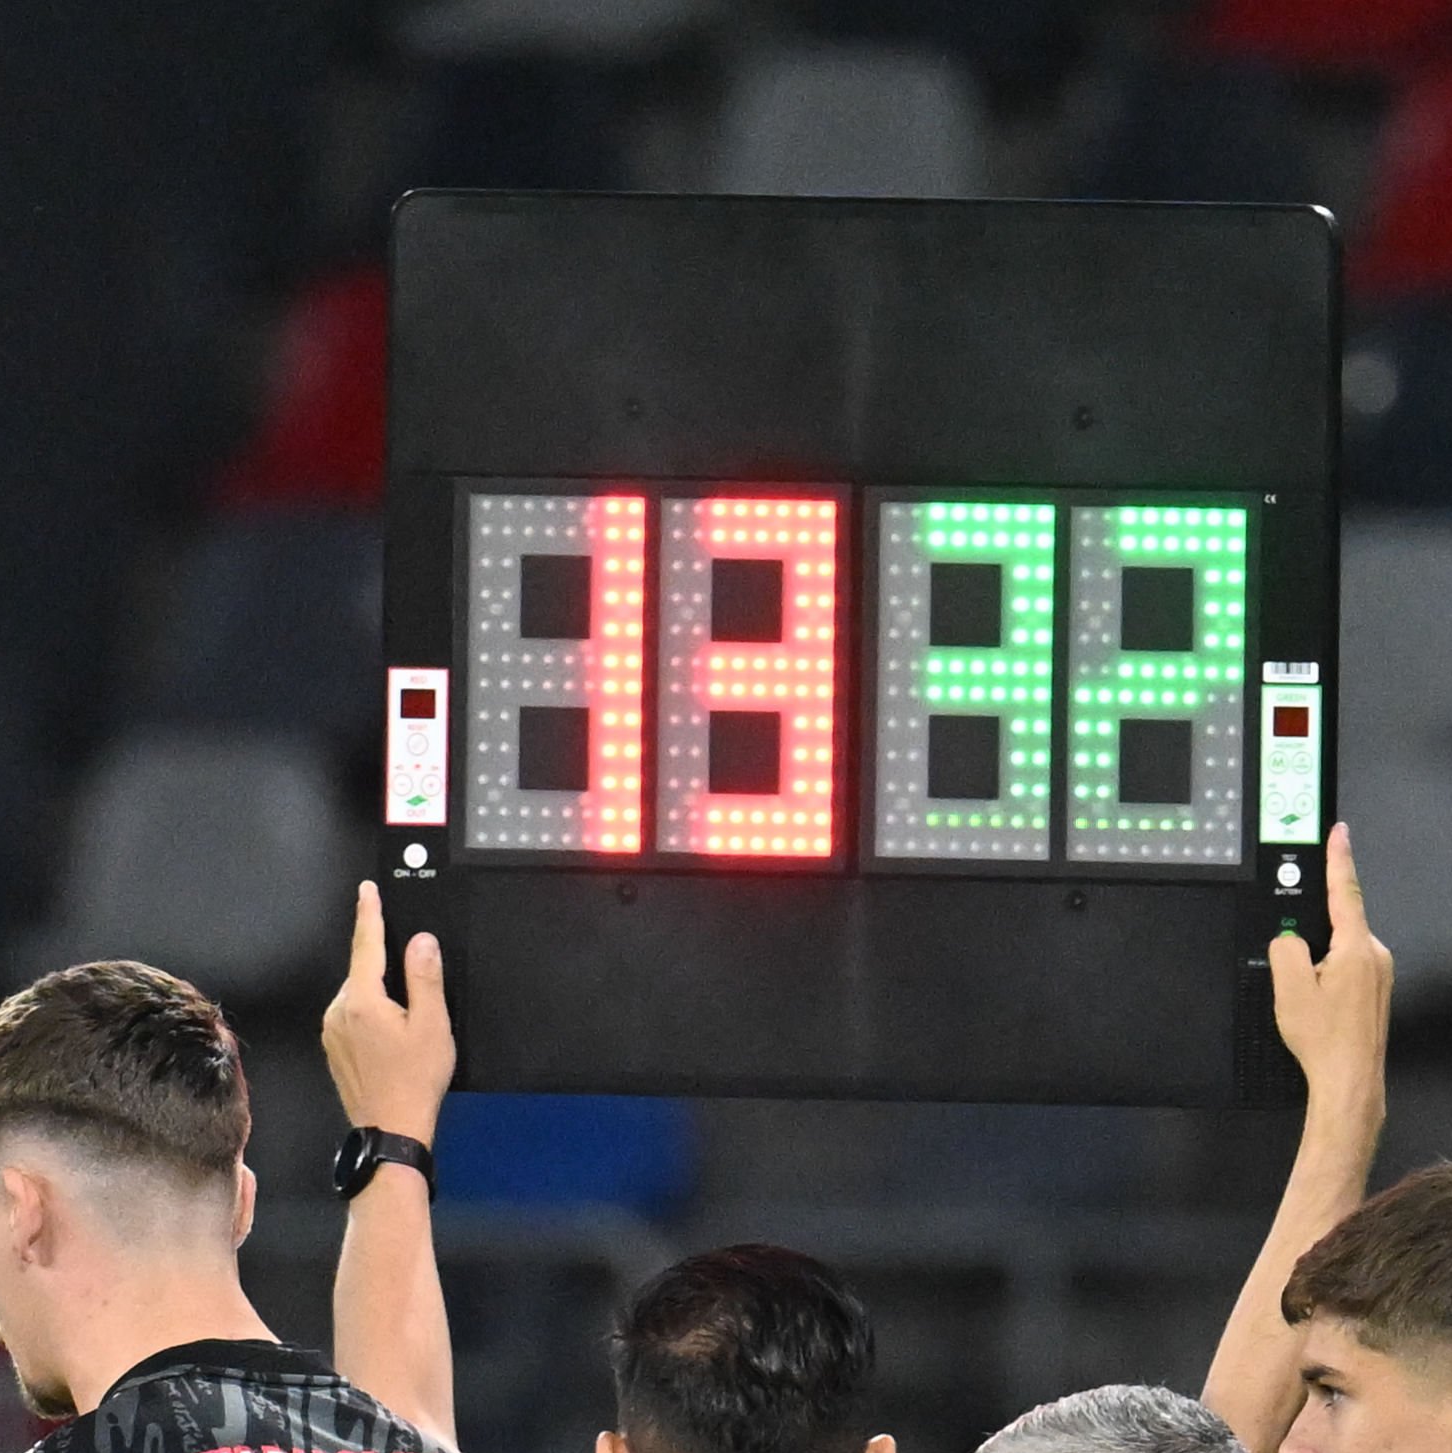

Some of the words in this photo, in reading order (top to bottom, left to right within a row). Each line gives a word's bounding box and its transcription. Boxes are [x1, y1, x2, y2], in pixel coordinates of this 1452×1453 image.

[592, 495, 838, 858] 13
[924, 501, 1247, 832] 32
[393, 869, 411, 878] ON
[418, 869, 437, 878] OFF
